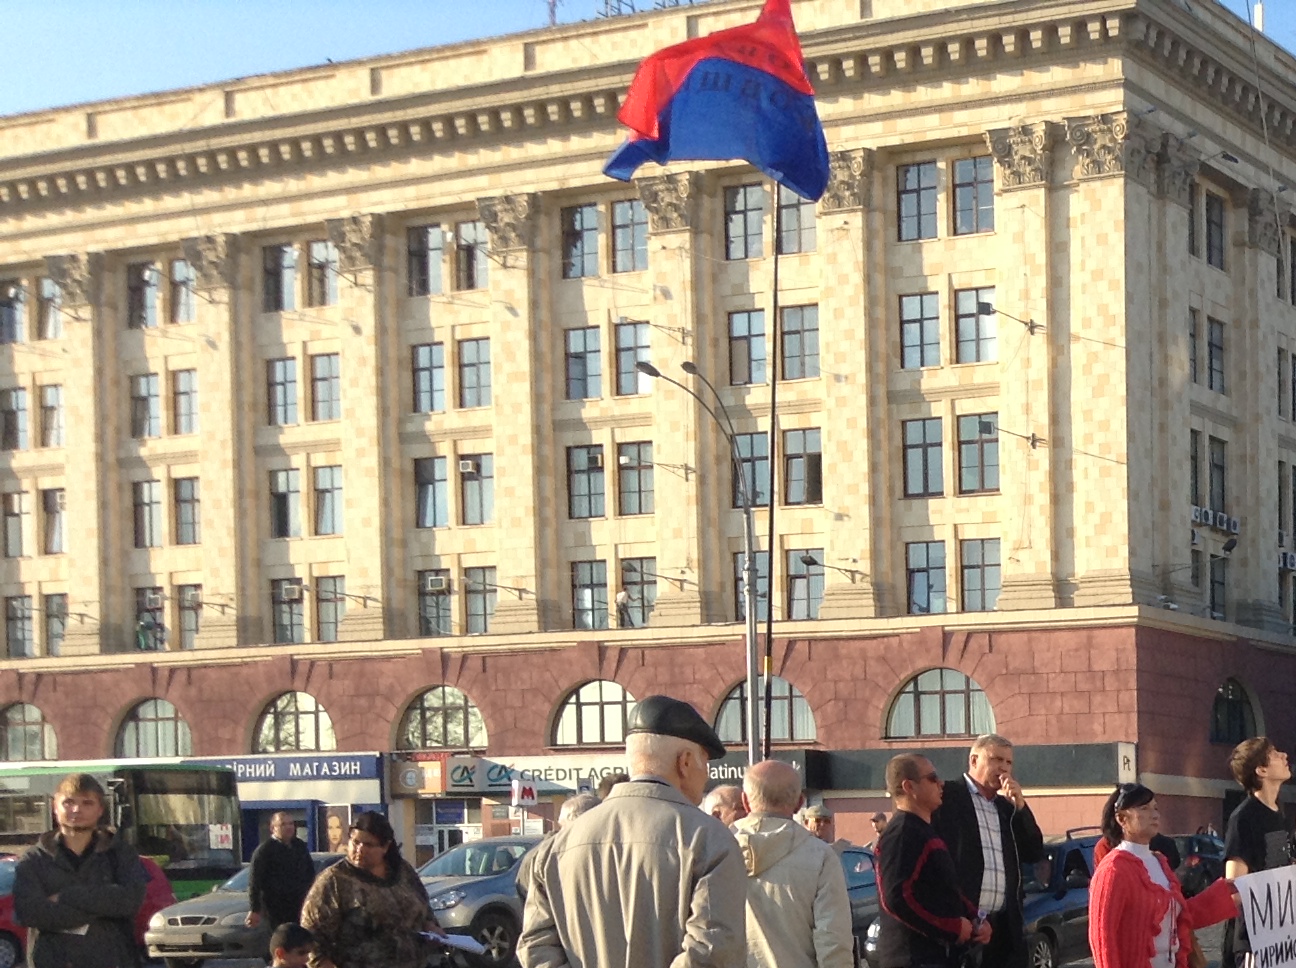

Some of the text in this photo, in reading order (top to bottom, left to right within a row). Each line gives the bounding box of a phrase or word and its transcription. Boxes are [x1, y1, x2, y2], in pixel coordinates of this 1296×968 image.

[226, 760, 361, 778] ІРНИЙ МАГАЗИН
[520, 765, 583, 782] CRÉDIT
[588, 766, 629, 781] AGRI
[707, 762, 745, 780] latinu
